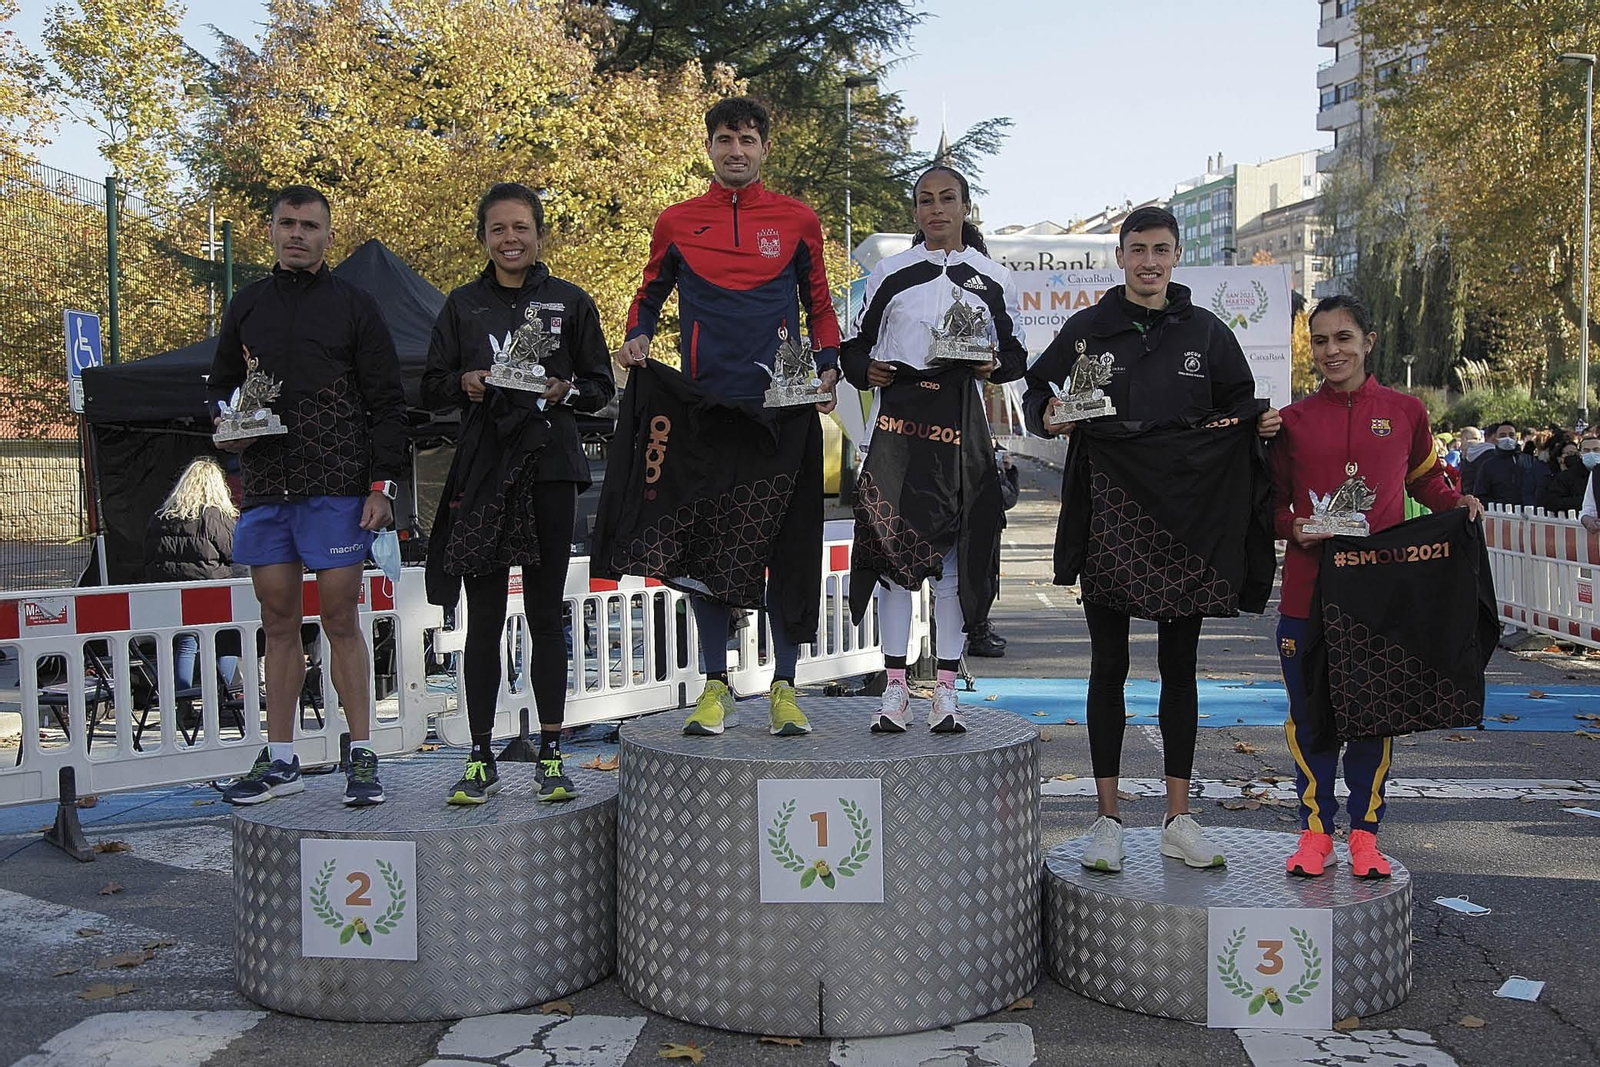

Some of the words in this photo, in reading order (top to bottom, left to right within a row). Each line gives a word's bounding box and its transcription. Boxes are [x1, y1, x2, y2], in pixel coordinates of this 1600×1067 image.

[963, 282, 988, 291] adidas
[1067, 273, 1115, 284] CaixaBank
[920, 381, 940, 391] OCHO
[645, 415, 672, 484] OCHO
[329, 543, 364, 554] macron
[1333, 541, 1450, 568] #SMOU2021
[809, 811, 828, 847] 1
[345, 871, 372, 906] 2
[1254, 940, 1284, 976] 3
